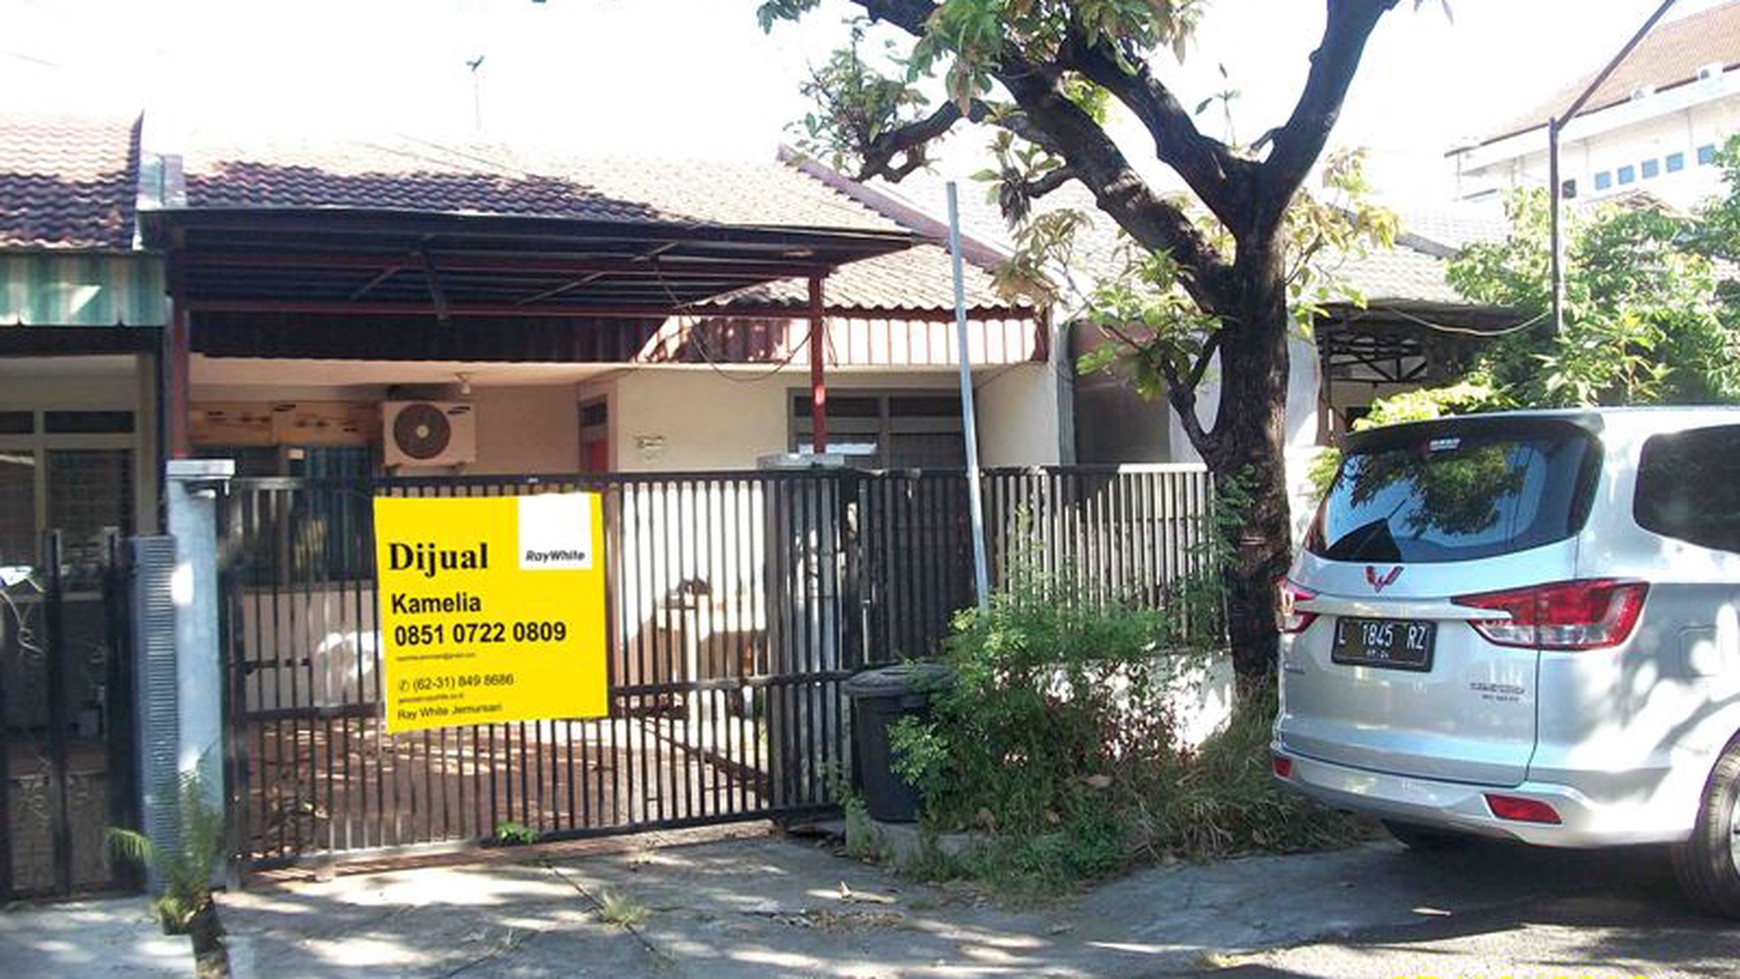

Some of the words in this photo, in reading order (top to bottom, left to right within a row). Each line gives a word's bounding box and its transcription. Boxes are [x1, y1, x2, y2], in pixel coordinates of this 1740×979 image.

[389, 543, 489, 577] Dijual
[525, 550, 585, 563] RayWhite
[391, 592, 481, 614] Kamelia
[395, 624, 444, 646] 0851
[453, 622, 505, 643] 0722
[513, 621, 566, 642] 0809
[1338, 622, 1346, 645] L
[1362, 623, 1393, 647] 1845
[1406, 625, 1426, 650] RZ
[413, 676, 455, 692] (62-31)
[458, 674, 481, 687] 849
[397, 709, 418, 721] Ray
[419, 706, 449, 717] White
